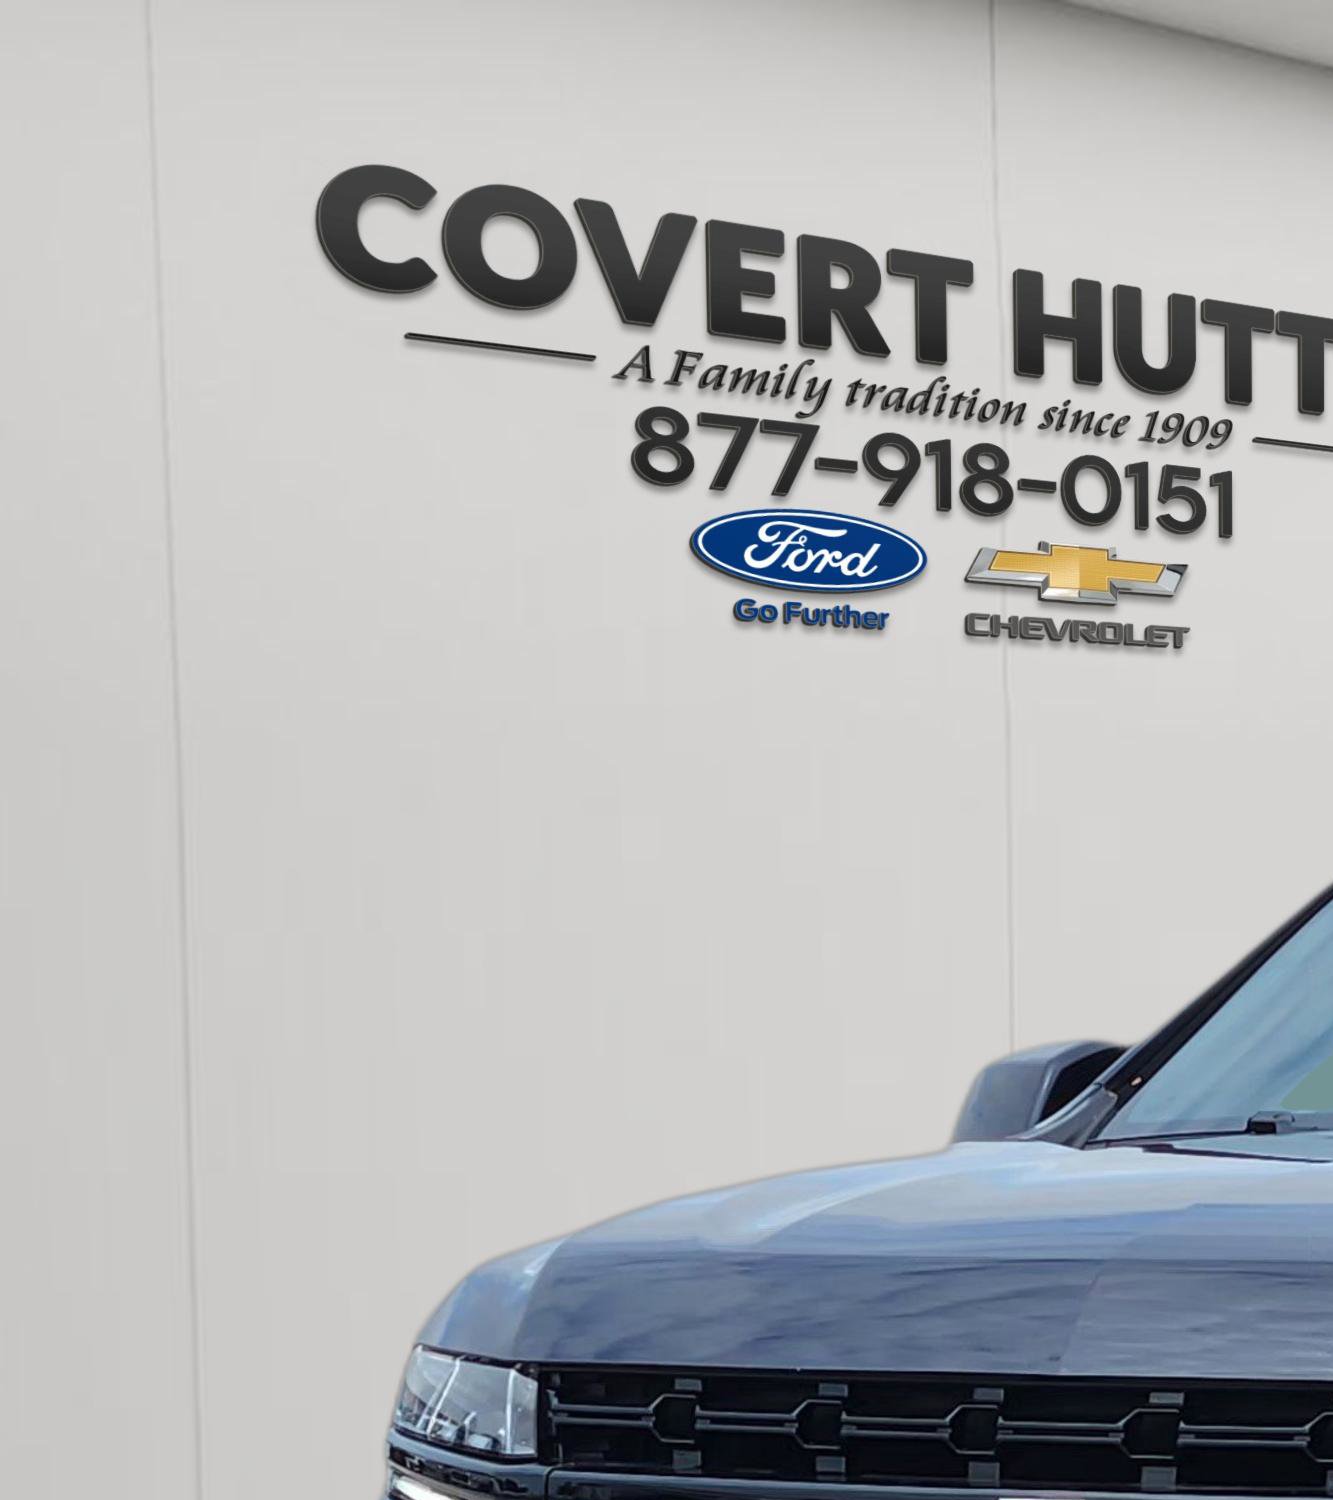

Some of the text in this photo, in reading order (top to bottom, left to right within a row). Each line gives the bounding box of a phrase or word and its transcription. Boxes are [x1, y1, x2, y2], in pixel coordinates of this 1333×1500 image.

[316, 163, 974, 366] COVERT
[611, 345, 1234, 451] A Family tradition since 1909
[630, 405, 1234, 540] 877-918-0151
[743, 519, 882, 580] Ford
[733, 597, 890, 631] Go Further
[964, 611, 1191, 650] CHEVROLET
